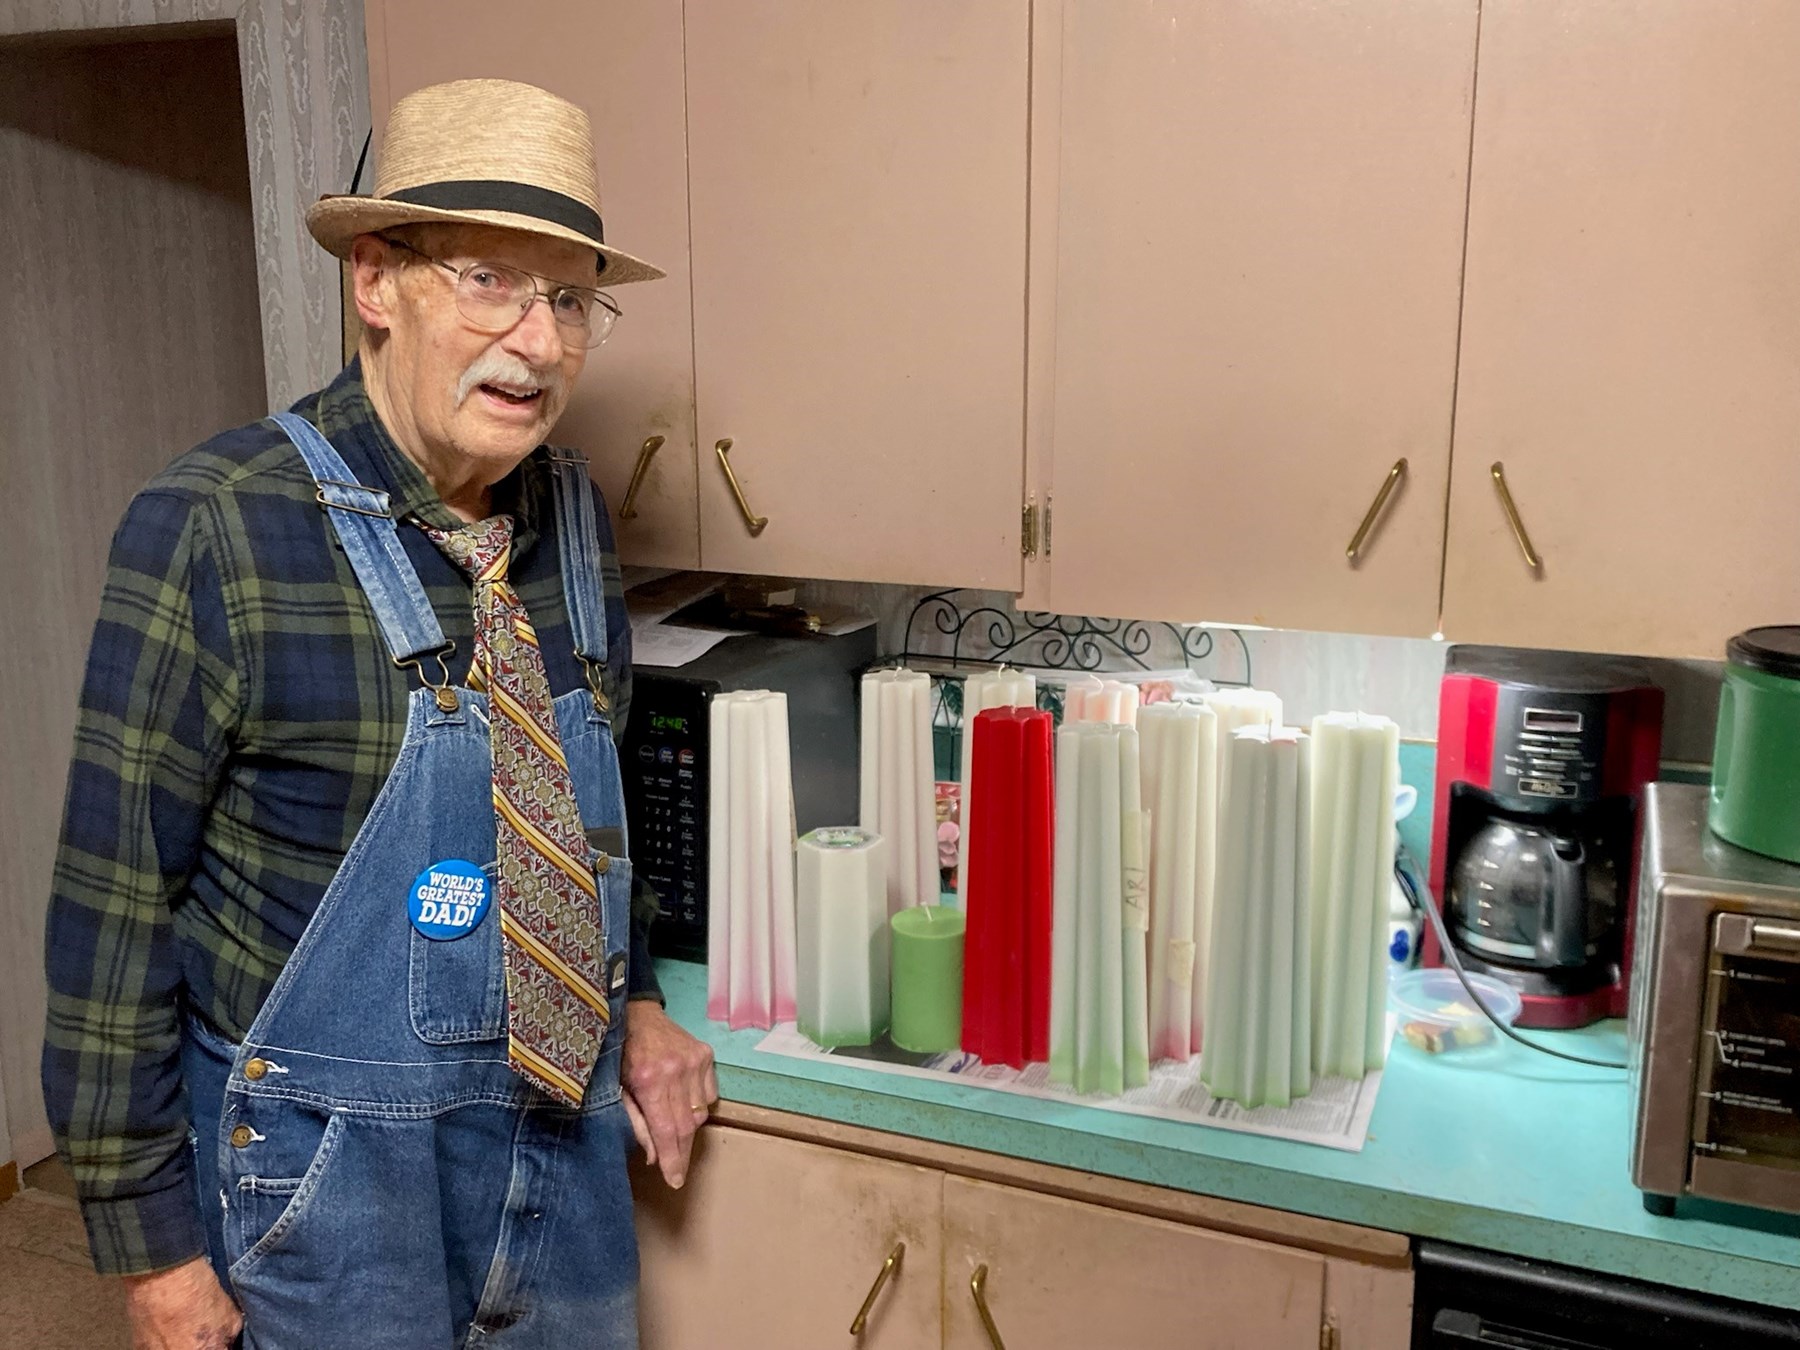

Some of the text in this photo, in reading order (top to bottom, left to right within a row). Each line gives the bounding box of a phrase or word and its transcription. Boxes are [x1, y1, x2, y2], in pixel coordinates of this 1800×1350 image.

[430, 872, 484, 892] WORLD'S
[417, 885, 485, 906] GREATEST
[418, 901, 476, 927] DAD!
